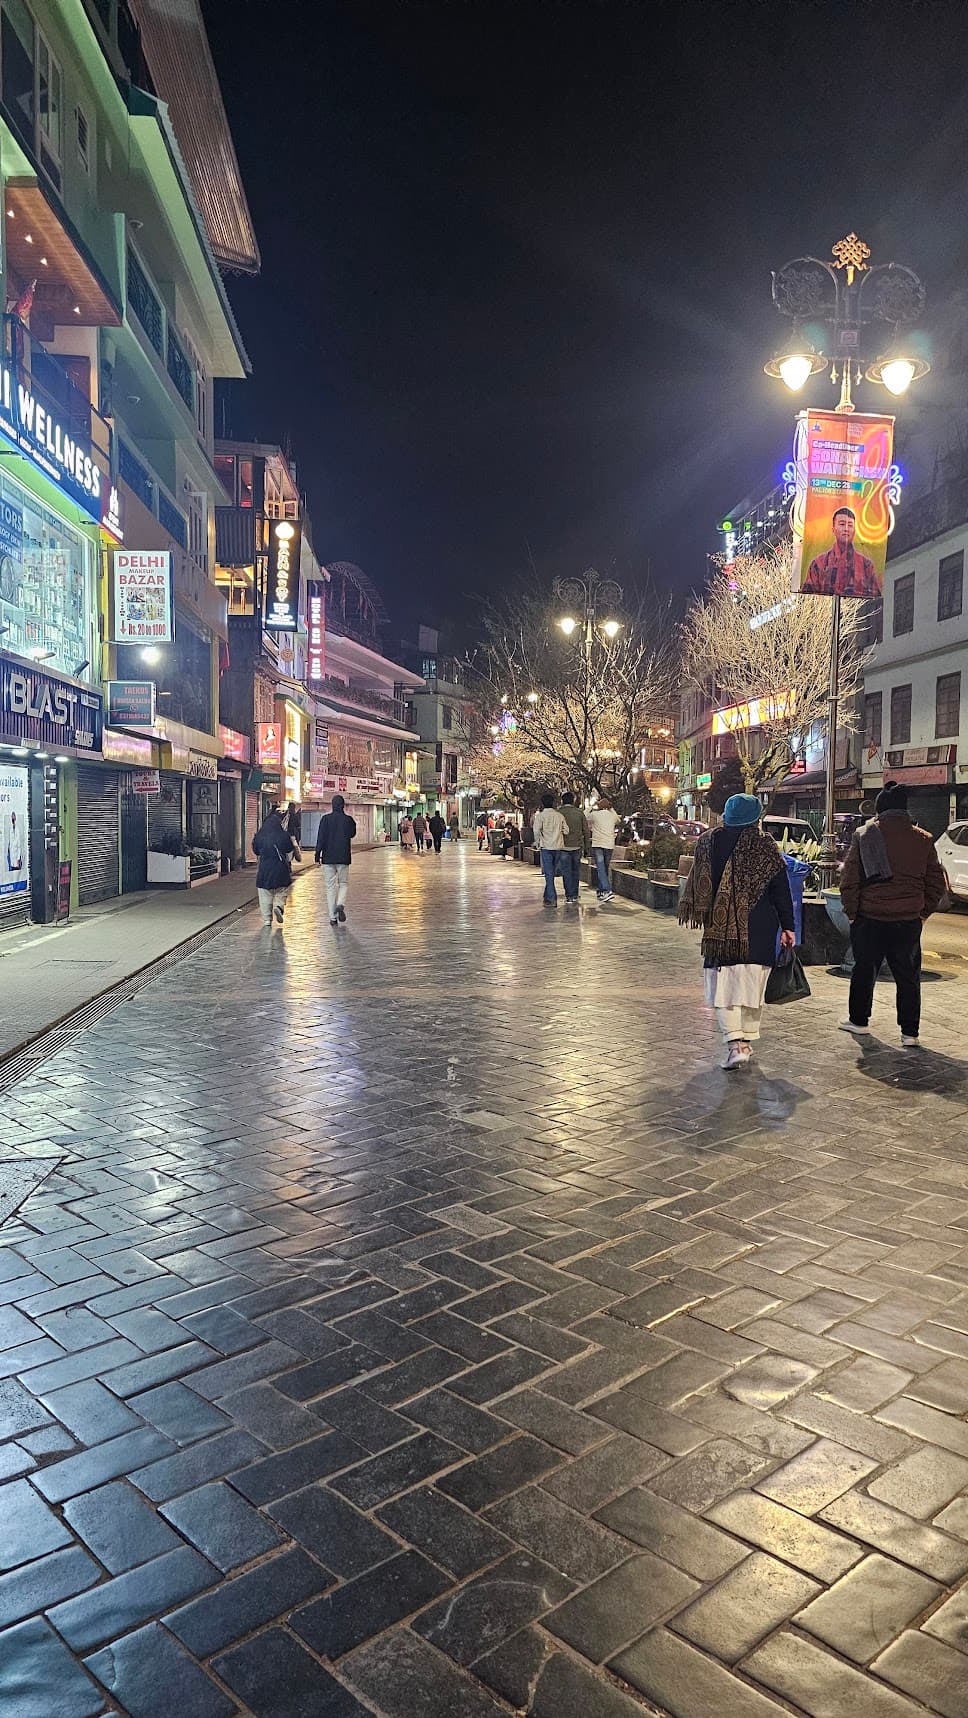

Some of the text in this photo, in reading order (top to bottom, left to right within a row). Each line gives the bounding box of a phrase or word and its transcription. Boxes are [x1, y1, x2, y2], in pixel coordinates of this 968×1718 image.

[18, 384, 101, 498] WELLNESS
[811, 450, 860, 465] SONAM
[826, 480, 842, 488] DEC
[118, 555, 165, 568] DELHI
[119, 574, 165, 585] BAZAR
[137, 624, 145, 636] 20
[11, 672, 78, 728] BLAST
